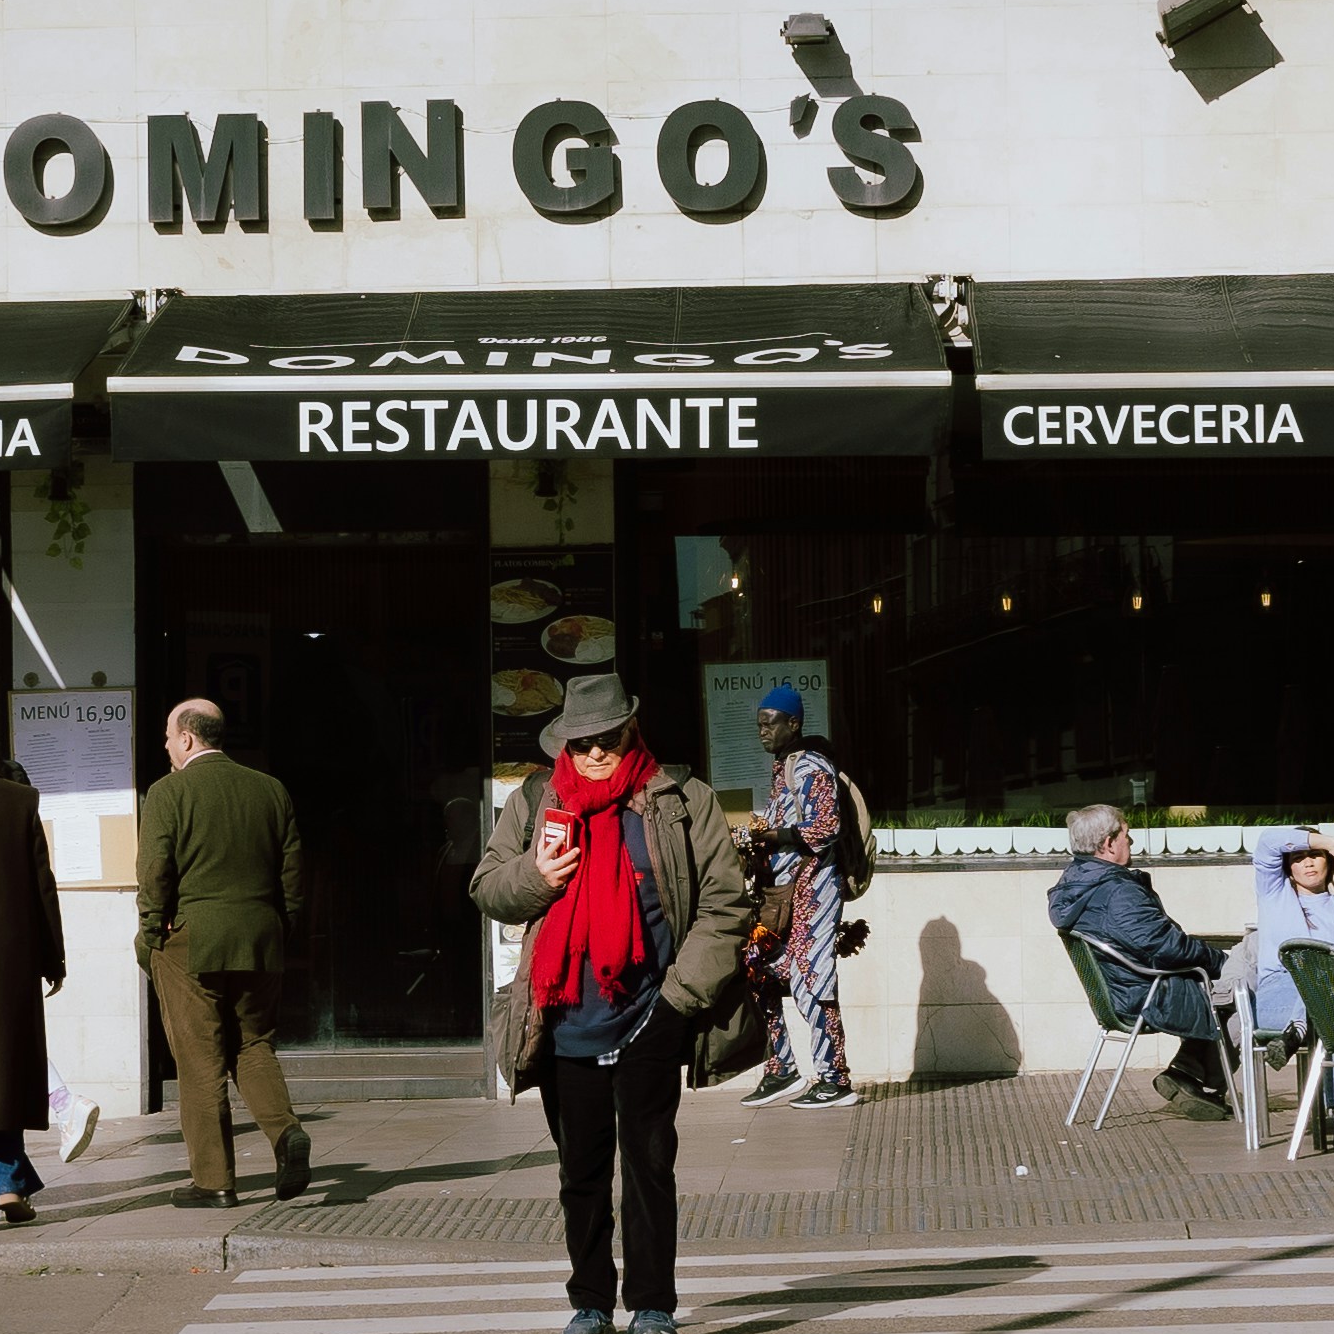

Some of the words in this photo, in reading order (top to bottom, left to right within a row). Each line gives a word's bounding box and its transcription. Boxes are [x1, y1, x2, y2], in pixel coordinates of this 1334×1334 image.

[477, 337, 546, 345] Desde
[550, 335, 608, 344] 1986
[175, 339, 894, 370] DOMINGO'S
[298, 397, 759, 453] RESTAURANTE
[1003, 403, 1304, 446] CERVECERIA
[714, 672, 764, 691] MENÚ
[20, 701, 70, 720] MENÚ
[76, 704, 126, 725] 16,90
